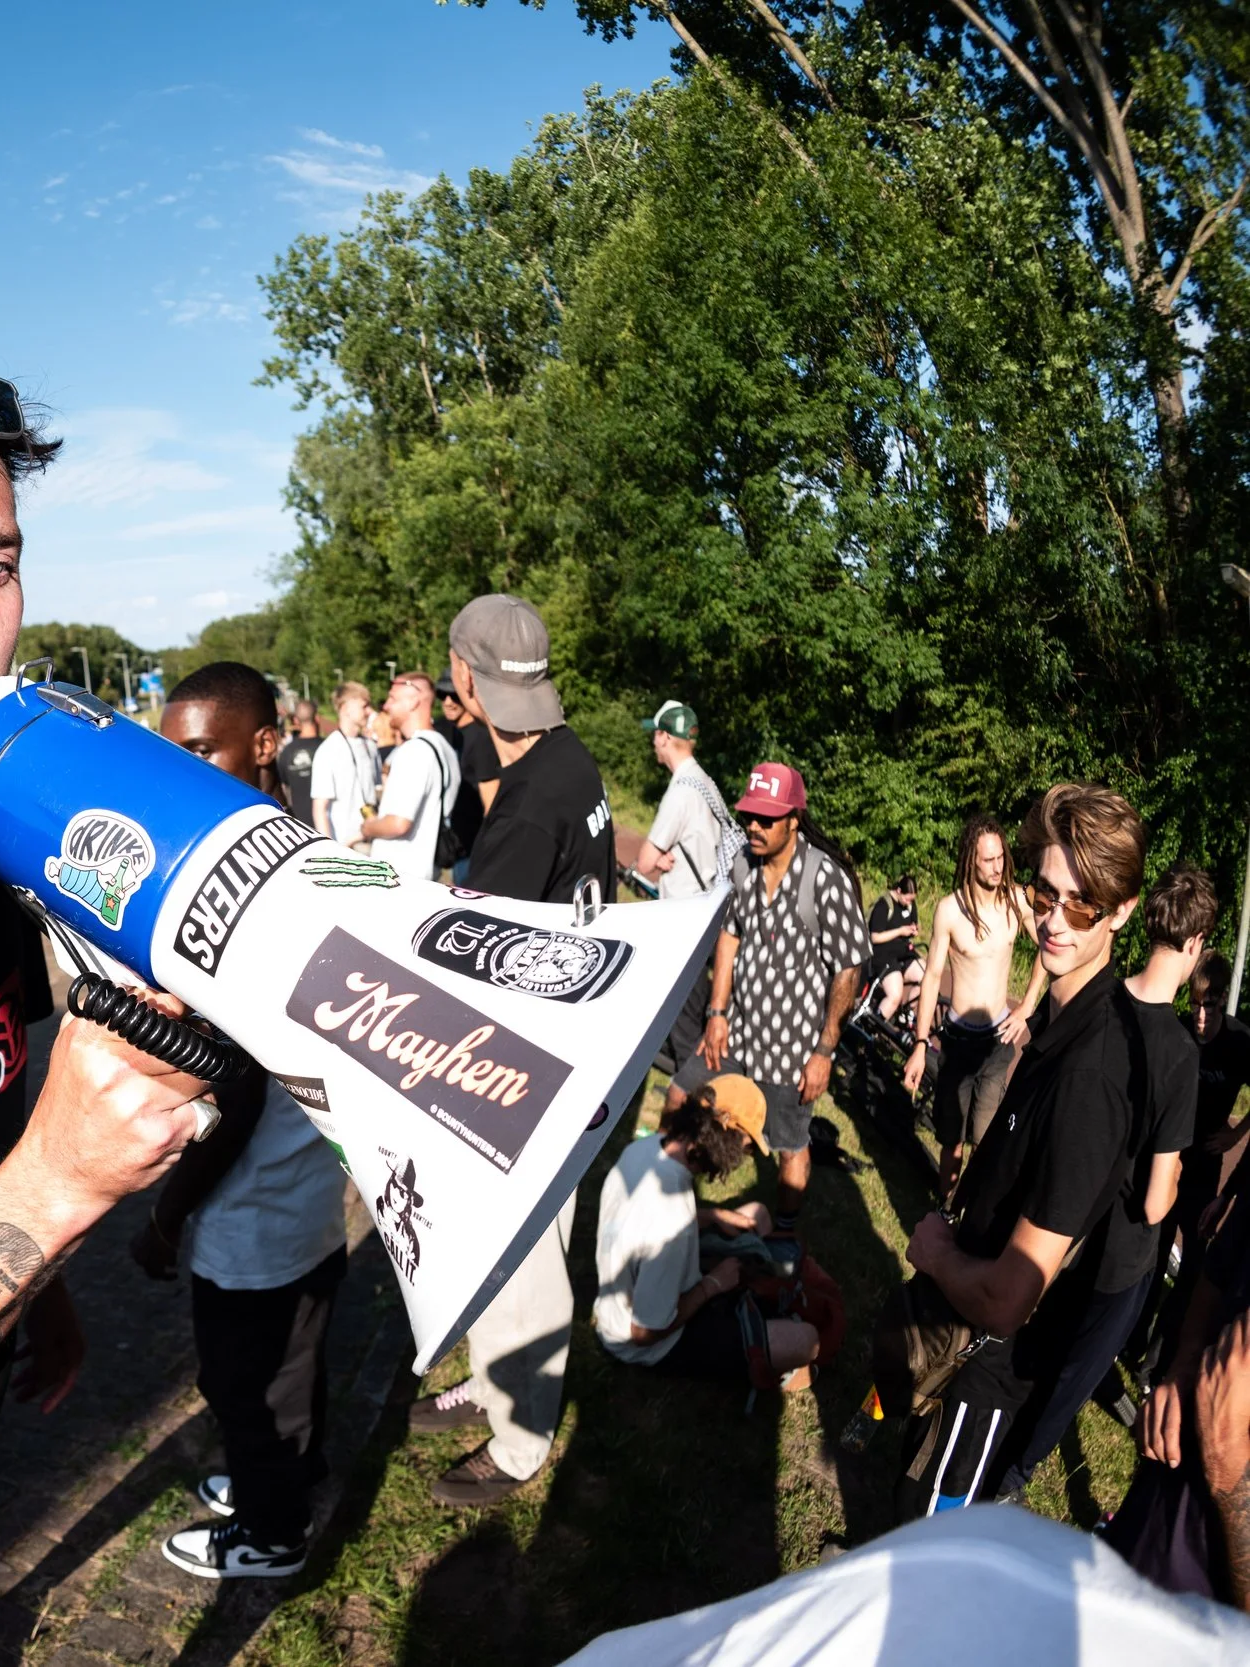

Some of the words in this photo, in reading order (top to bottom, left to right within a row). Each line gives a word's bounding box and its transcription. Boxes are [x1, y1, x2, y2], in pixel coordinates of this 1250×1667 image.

[750, 772, 780, 798] T-1
[504, 937, 548, 979] BMX
[313, 971, 529, 1107] Mayhem
